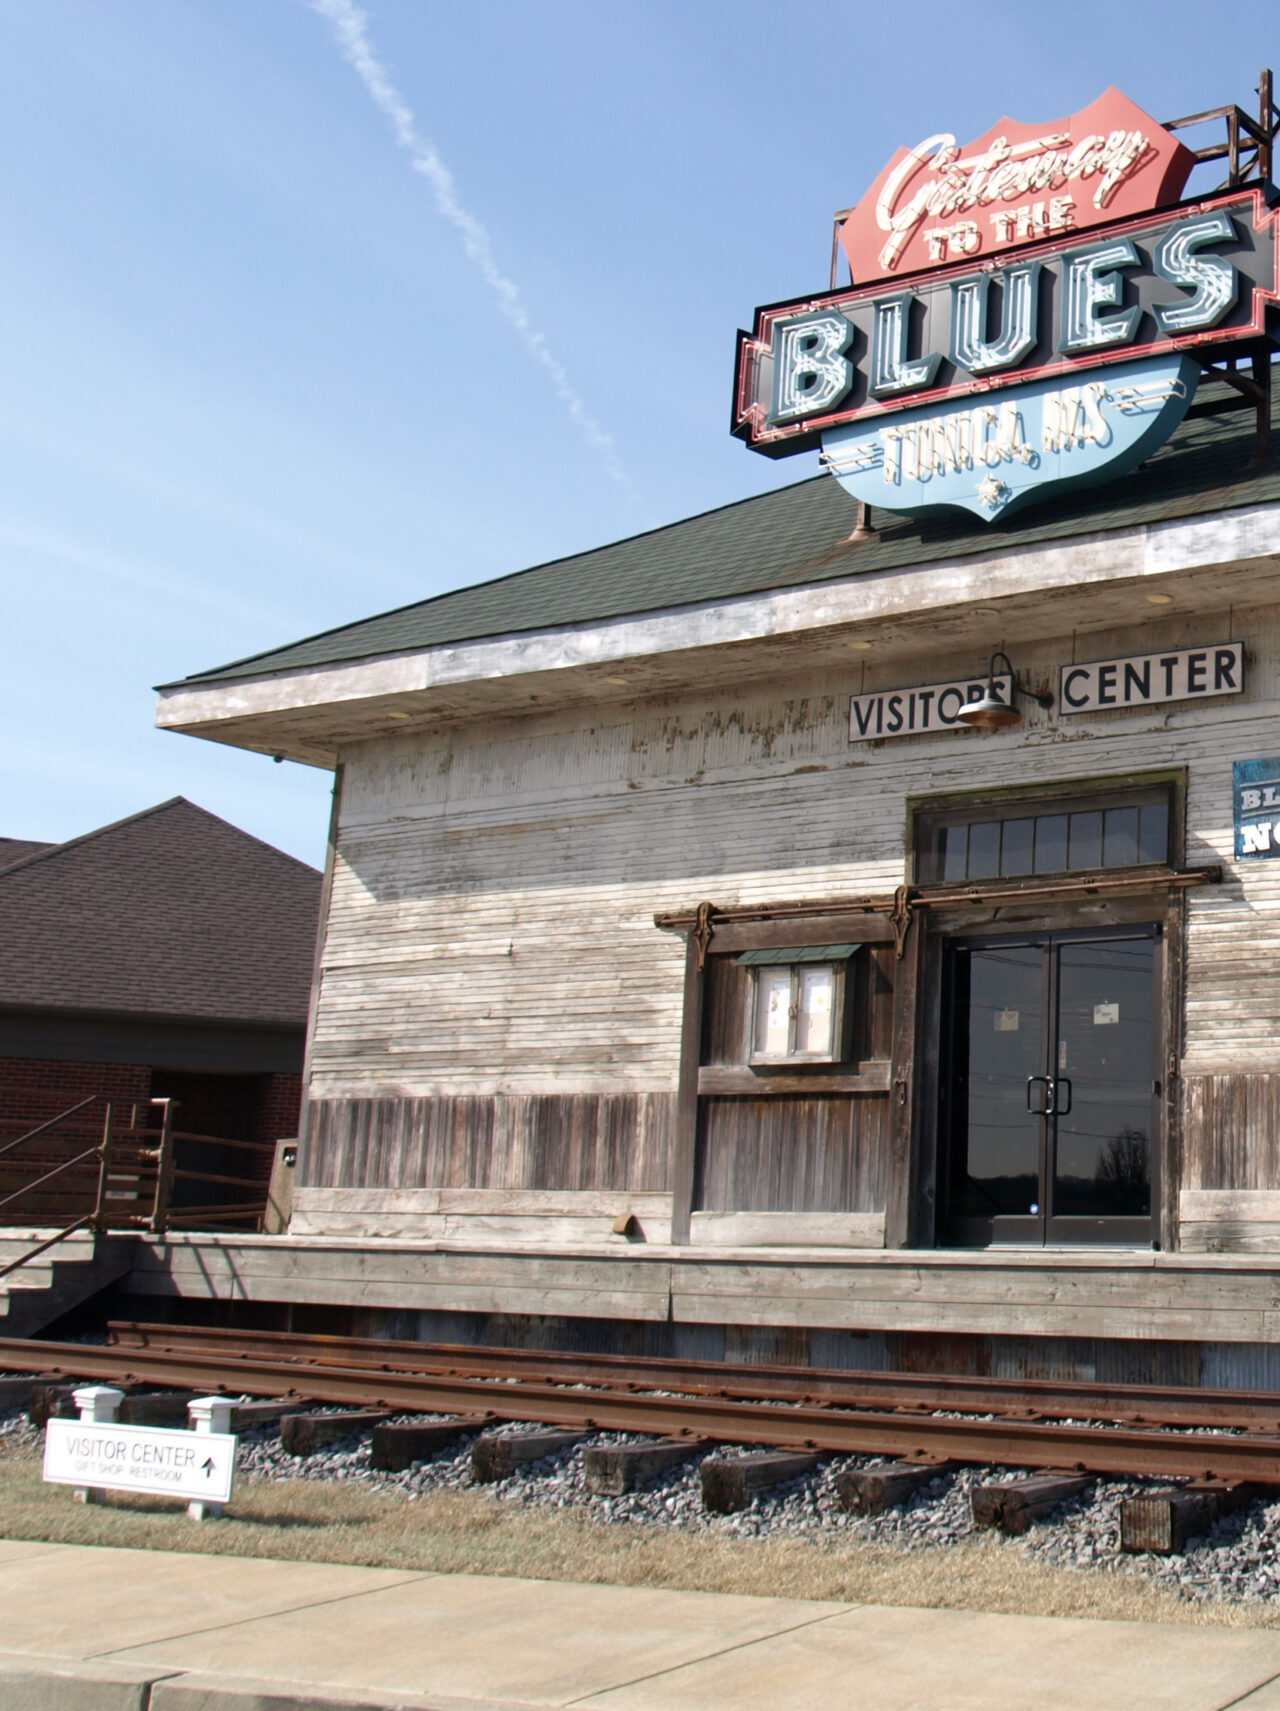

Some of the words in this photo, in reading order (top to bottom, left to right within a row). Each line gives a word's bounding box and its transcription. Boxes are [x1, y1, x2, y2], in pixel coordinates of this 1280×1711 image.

[876, 133, 1150, 270] Gateway
[924, 221, 978, 261] TO
[990, 195, 1074, 243] THE
[770, 210, 1240, 425] BLUES
[1043, 382, 1107, 452] MS
[1064, 649, 1238, 709] CENTER
[67, 1437, 127, 1461] VISITOR
[131, 1443, 195, 1467] CENTER
[75, 1460, 96, 1472] GIFT
[98, 1462, 124, 1475] SHOP
[129, 1465, 183, 1482] RESTROOM
